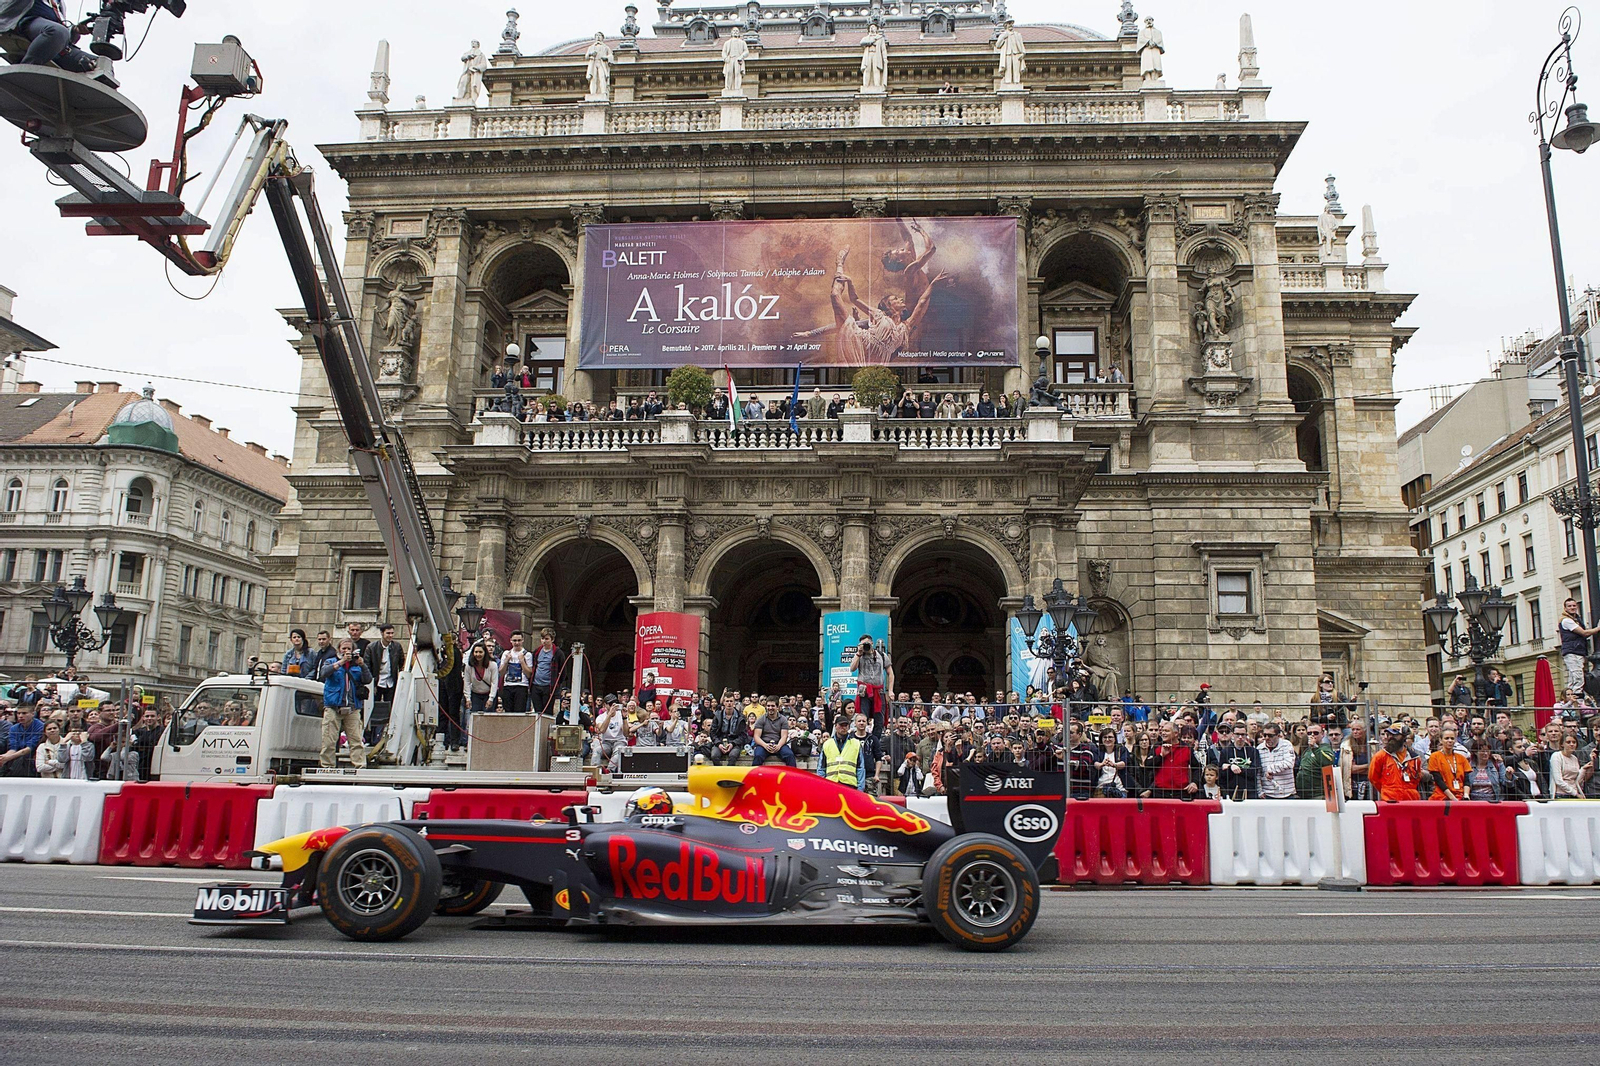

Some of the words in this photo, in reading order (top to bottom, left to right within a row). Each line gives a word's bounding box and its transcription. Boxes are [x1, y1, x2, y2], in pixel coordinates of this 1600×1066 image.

[602, 250, 667, 268] BALETT
[627, 272, 671, 280] Anna-Marie
[673, 271, 699, 279] Holmes
[707, 270, 738, 279] Solymosi
[740, 269, 764, 277] Tamás
[771, 268, 801, 278] Adolphe
[802, 268, 825, 276] Adam
[626, 287, 661, 322] A
[674, 282, 780, 322] kalóz
[642, 324, 655, 335] Le
[657, 322, 700, 334] Corsaire
[662, 344, 692, 352] Bemutató
[717, 343, 737, 352] április
[793, 343, 807, 352] April
[808, 343, 821, 351] 2017
[639, 625, 663, 637] OPERA
[827, 624, 850, 635] ERKEL
[202, 738, 249, 748] MTVA
[1004, 777, 1035, 789] AT&T
[1012, 814, 1051, 830] Esso
[565, 829, 581, 841] 3
[195, 888, 266, 911] Mobil
